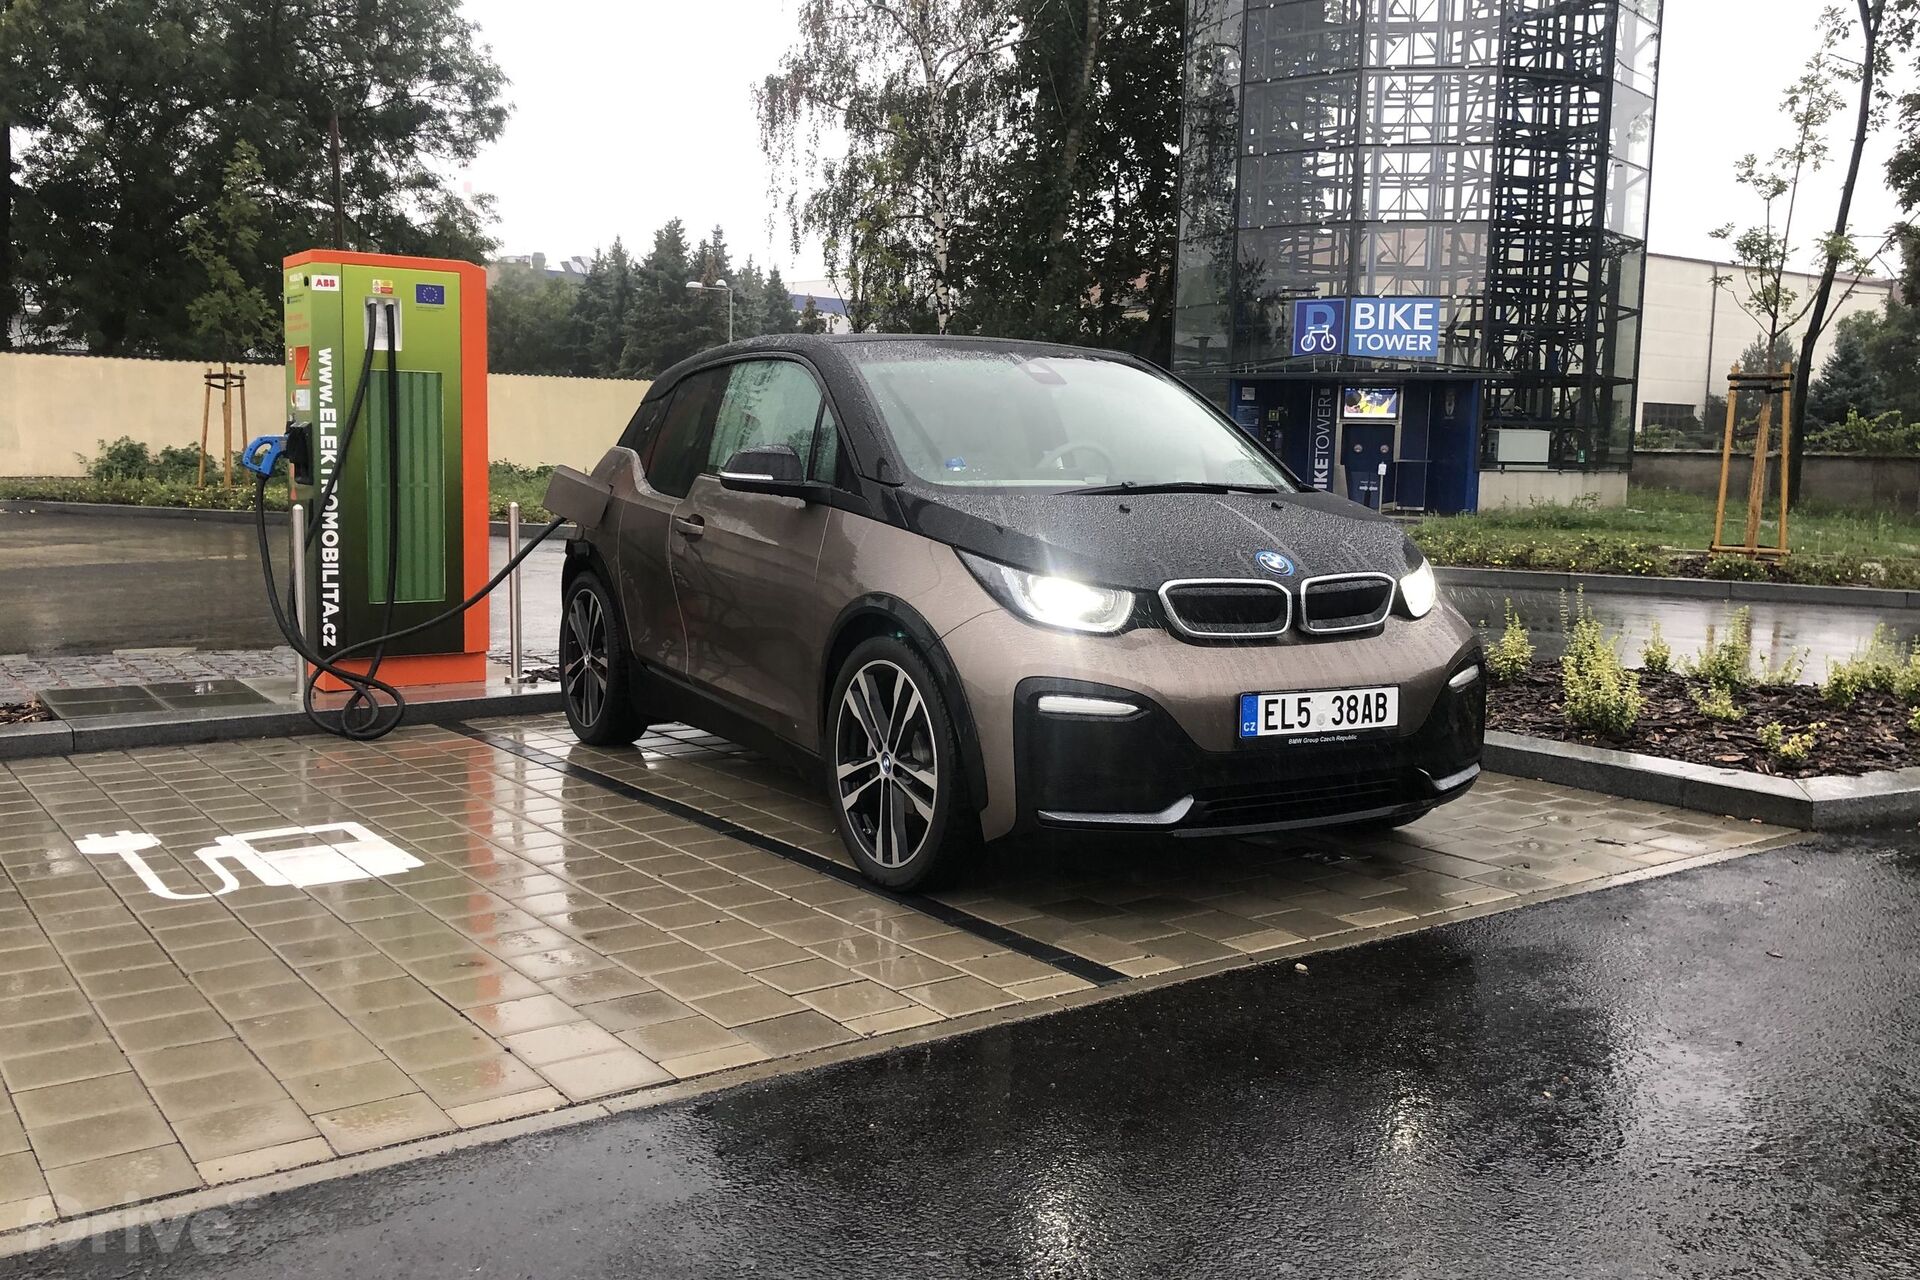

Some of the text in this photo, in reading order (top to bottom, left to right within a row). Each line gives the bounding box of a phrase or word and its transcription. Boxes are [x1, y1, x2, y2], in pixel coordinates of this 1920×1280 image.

[315, 278, 336, 288] ABB
[1354, 302, 1433, 331] BIKE
[1354, 333, 1432, 352] TOWER
[1313, 397, 1332, 489] IKETOWER
[1264, 692, 1387, 731] EL5 38AB
[1243, 722, 1256, 732] CZ
[1336, 734, 1358, 743] Republic
